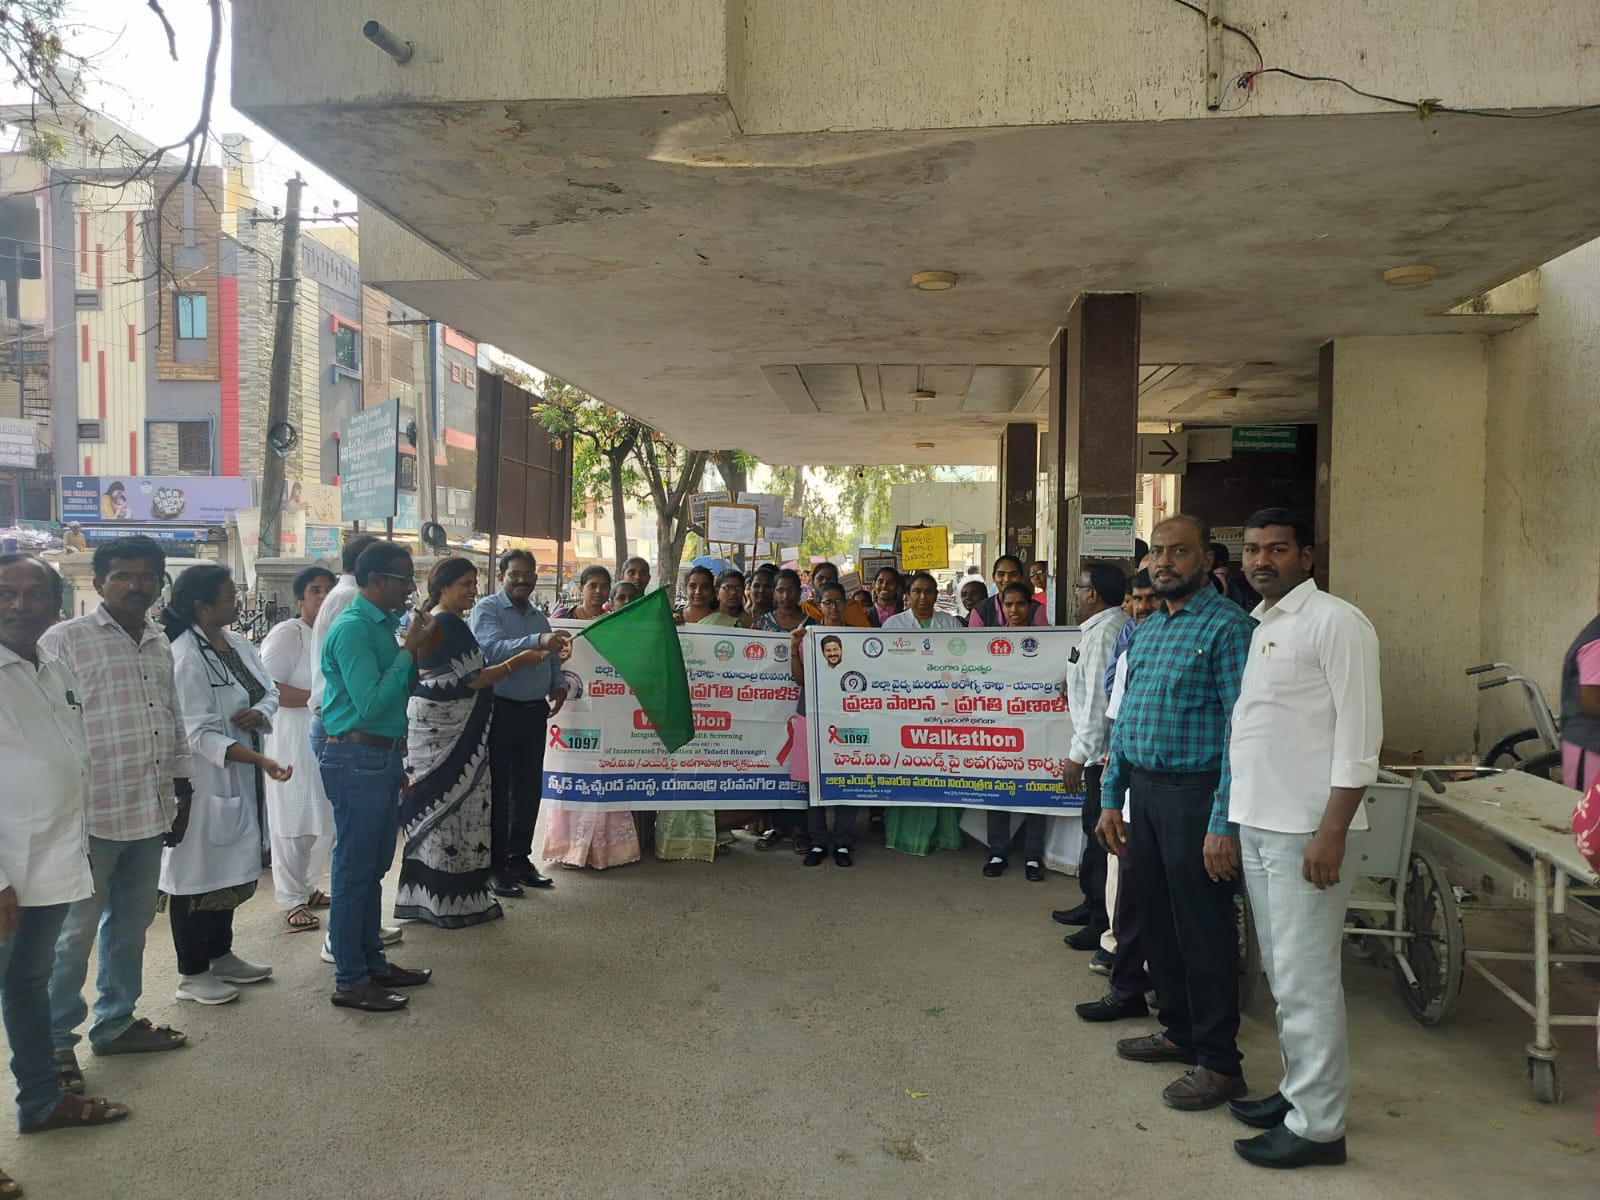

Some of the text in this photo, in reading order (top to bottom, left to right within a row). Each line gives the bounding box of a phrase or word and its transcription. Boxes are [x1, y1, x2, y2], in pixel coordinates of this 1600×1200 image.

[588, 680, 625, 697] ప్రజా
[691, 683, 800, 701] ప్రగతి ప్రణాళిక
[871, 680, 890, 692] జిల్లా
[892, 680, 911, 693] వైద్య
[912, 680, 949, 689] మరియు
[983, 681, 1004, 691] శాఖ
[842, 695, 882, 712] ప్రజా
[886, 694, 936, 711] పాలన
[954, 696, 1002, 713] ప్రగతి
[709, 732, 743, 740] Screening
[844, 734, 868, 744] 1097
[909, 728, 1017, 748] Walkathon
[569, 737, 598, 749] 1097
[662, 779, 717, 791] యాదాద్రి
[720, 778, 776, 791] భువనగిరి
